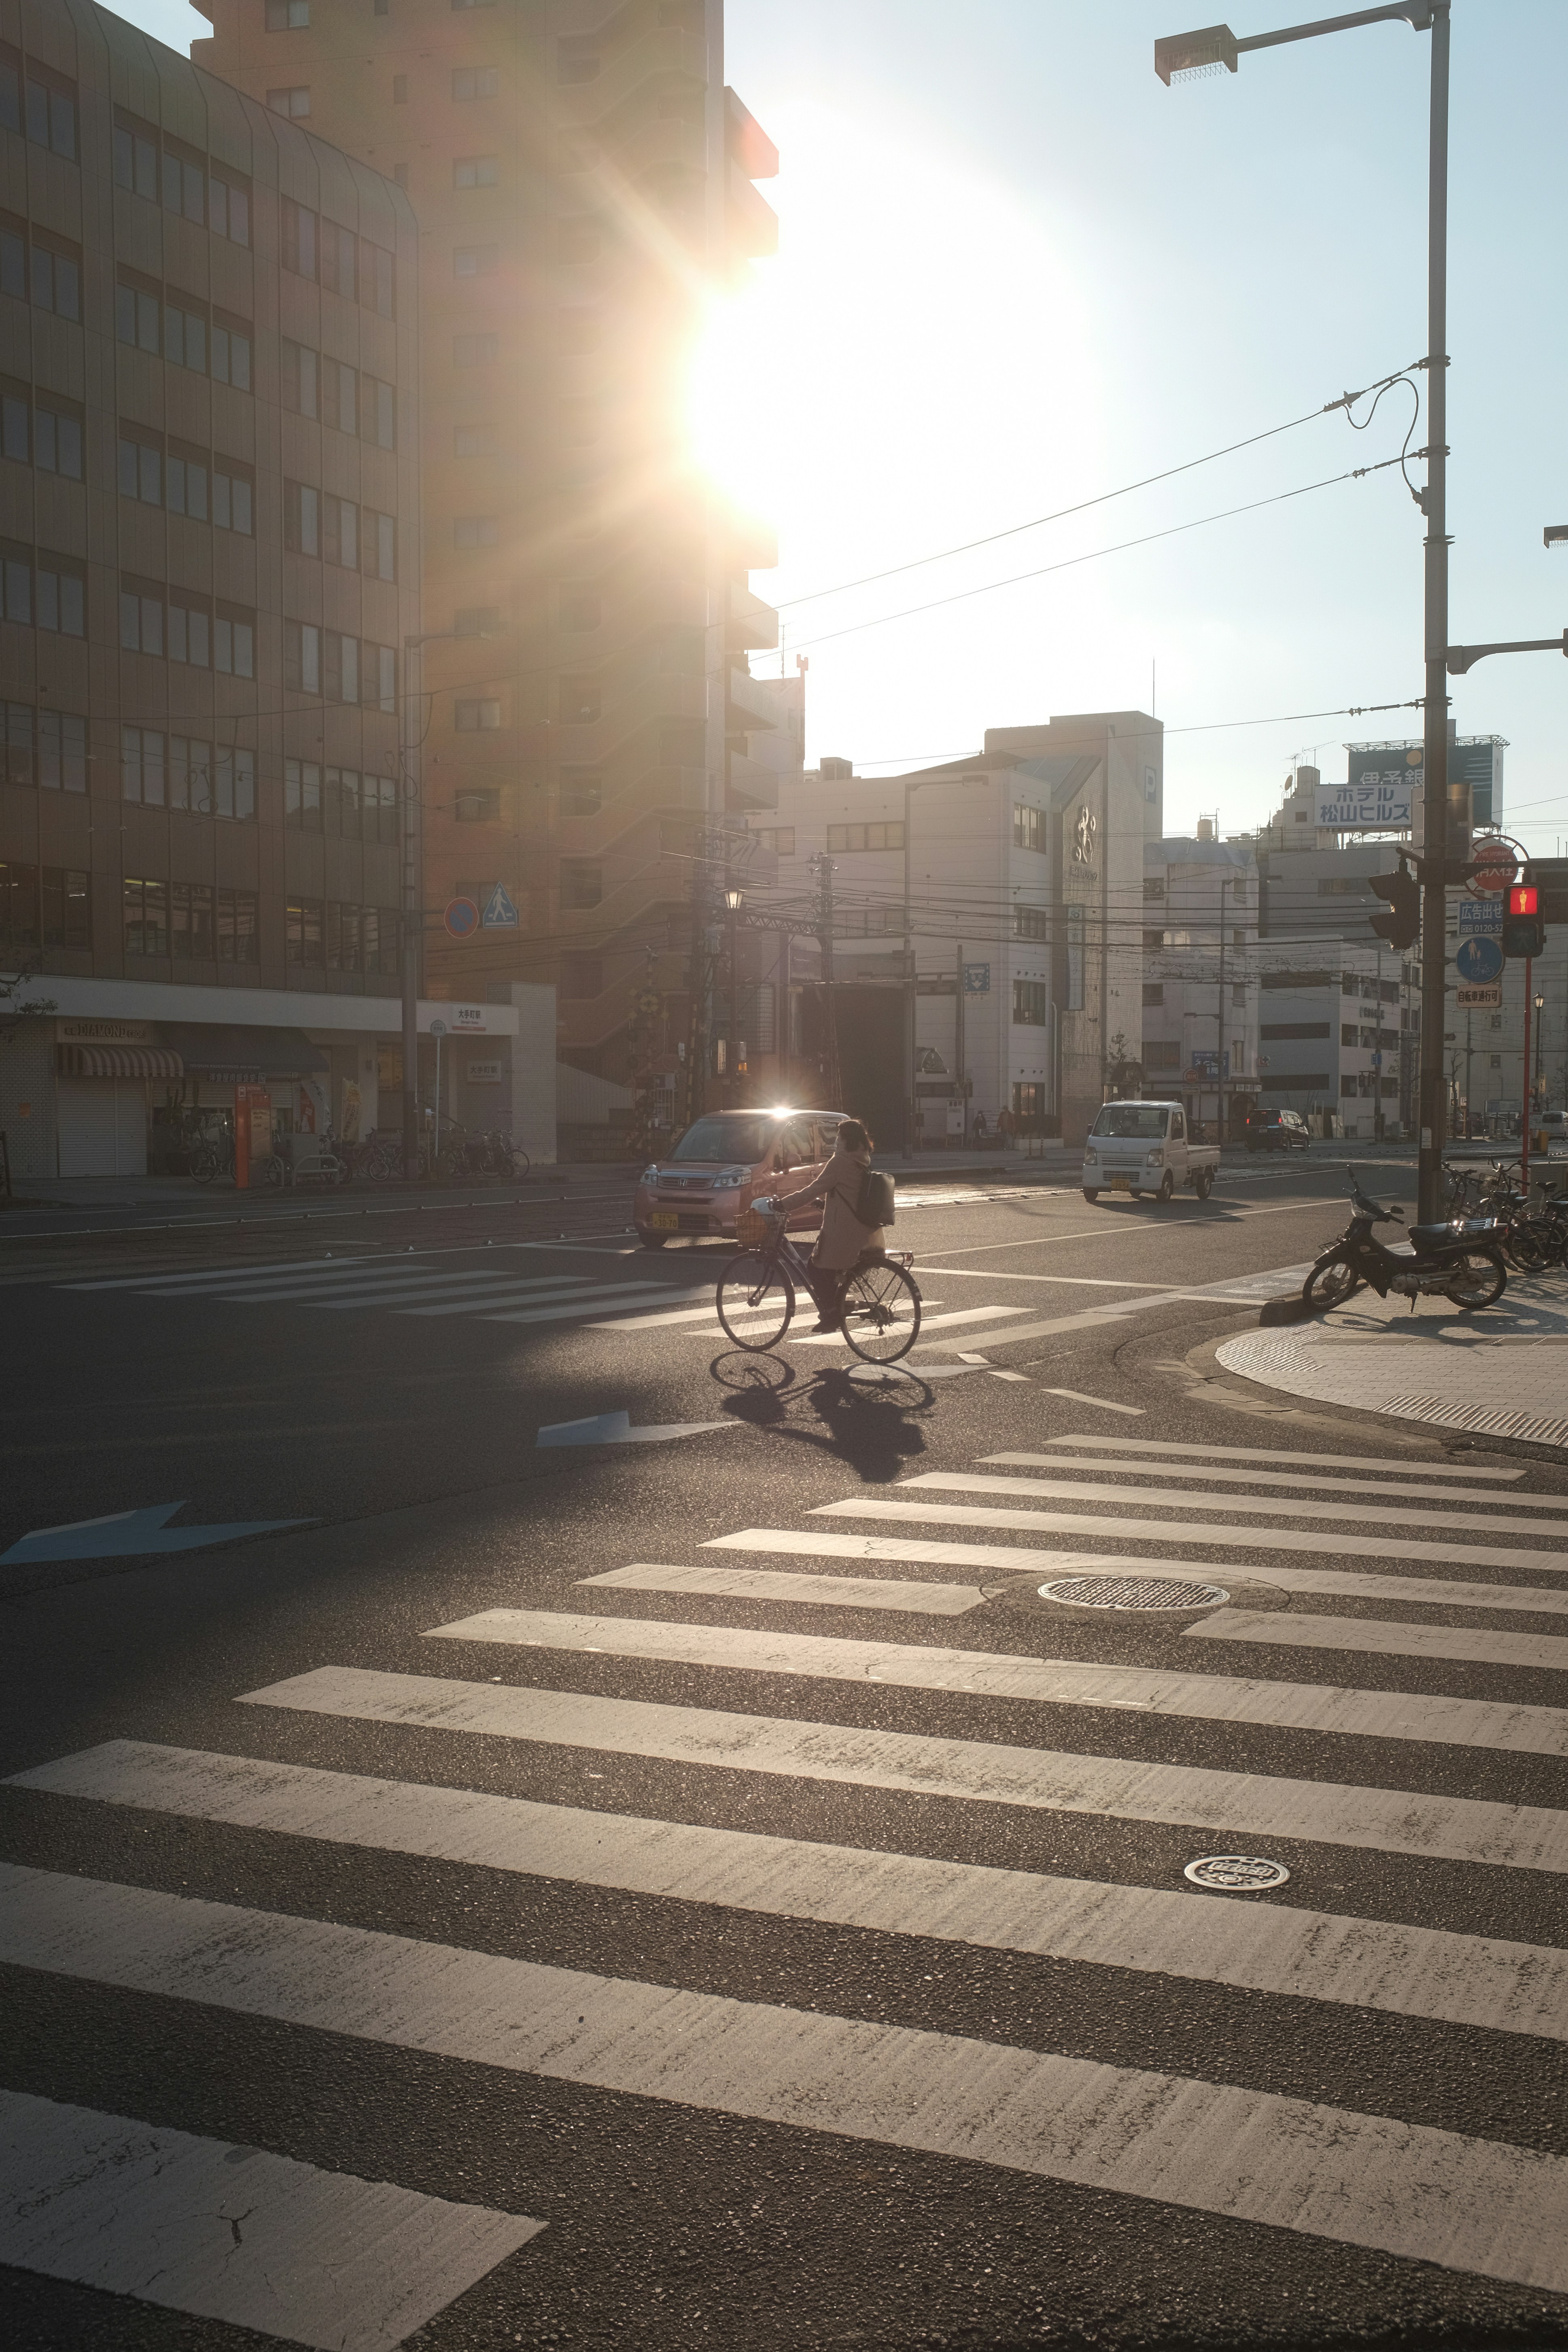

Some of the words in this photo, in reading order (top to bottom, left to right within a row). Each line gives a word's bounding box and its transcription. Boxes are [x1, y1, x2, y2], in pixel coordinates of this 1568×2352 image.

[1336, 787, 1394, 802] ホテル
[1320, 803, 1410, 823] 松山ヒルズ
[1461, 903, 1503, 920] 広告出せ
[1475, 924, 1503, 932] 0120-52
[1458, 990, 1498, 1002] 自転車通行可
[458, 1009, 481, 1019] 大手町駅
[78, 1024, 126, 1037] DIAMOND
[658, 1219, 677, 1227] 30-70
